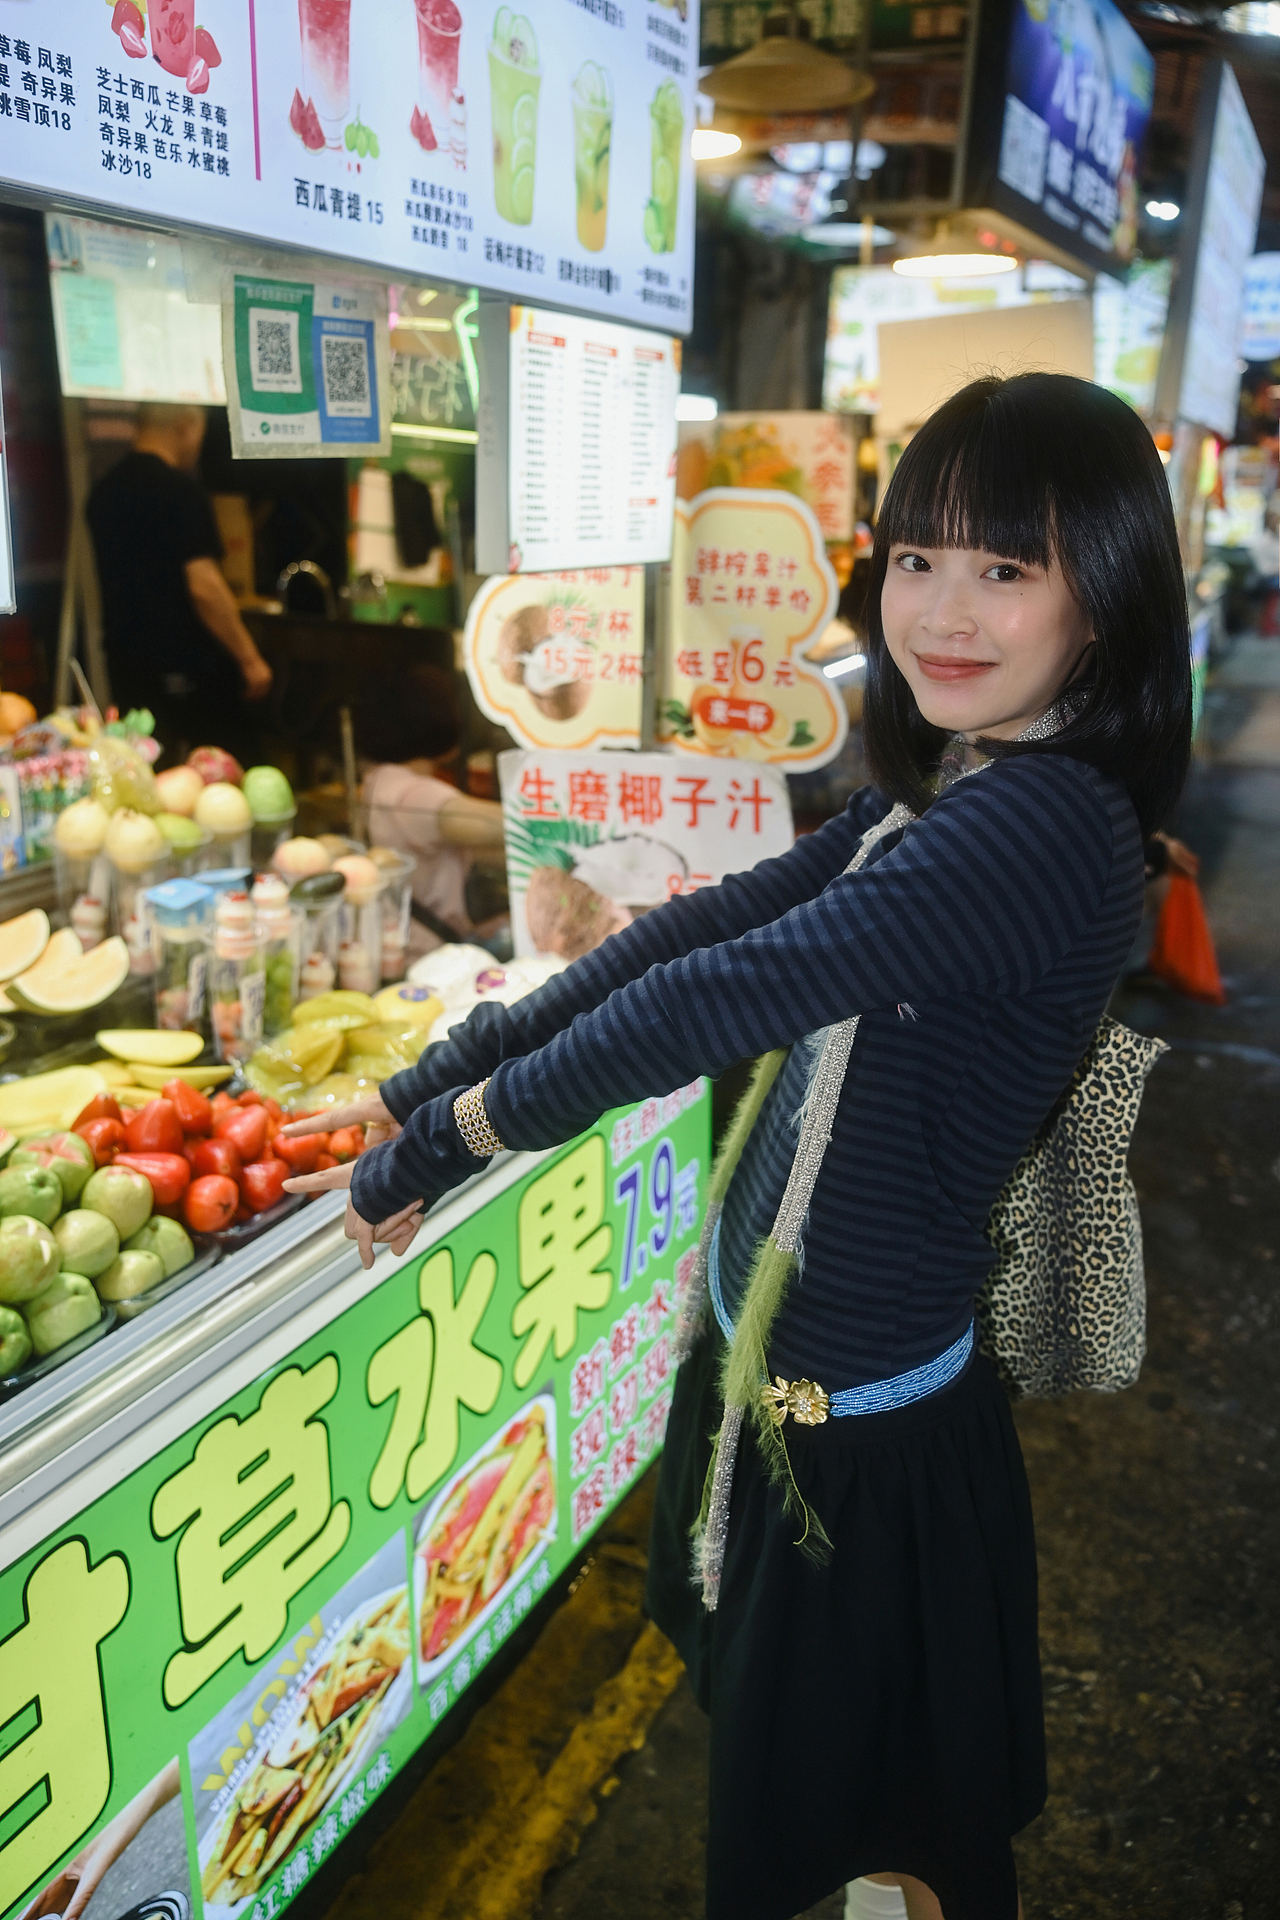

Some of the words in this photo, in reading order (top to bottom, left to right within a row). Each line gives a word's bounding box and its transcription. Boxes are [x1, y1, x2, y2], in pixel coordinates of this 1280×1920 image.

[38, 46, 73, 78] 凤梨
[21, 70, 75, 106] 奇异果
[96, 66, 161, 106] 芝士西瓜
[165, 90, 196, 117] 芒果
[199, 101, 228, 127] 草莓
[98, 94, 131, 123] 凤梨
[99, 122, 149, 155] 奇异果
[153, 138, 183, 163] 芭乐
[188, 150, 230, 177] 水蜜桃
[101, 150, 152, 179] 冰沙18
[294, 177, 363, 222] 西瓜青提
[366, 201, 384, 225] 15
[519, 767, 773, 834] 生磨椰子汁
[202, 1614, 323, 1790] WOW
